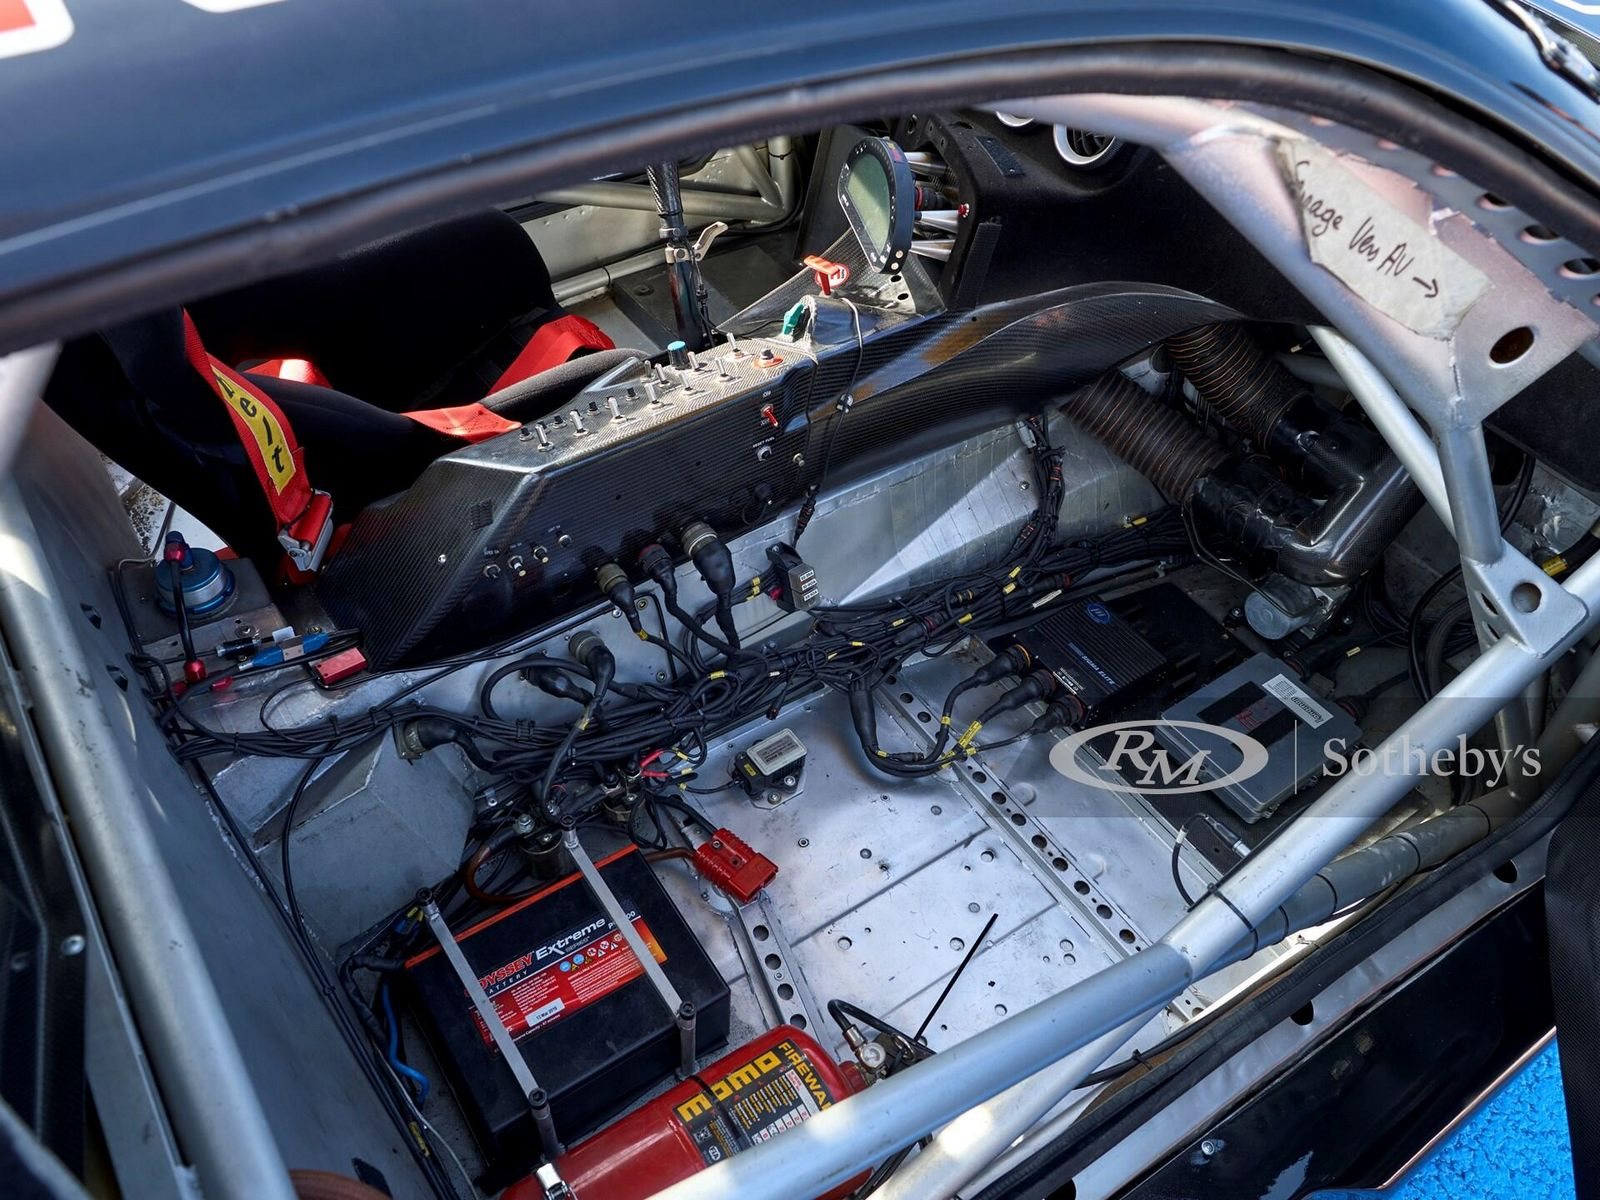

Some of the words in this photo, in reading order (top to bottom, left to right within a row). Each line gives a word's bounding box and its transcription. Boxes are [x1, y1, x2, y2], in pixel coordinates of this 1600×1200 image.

[464, 951, 534, 998] DYSSEY
[535, 917, 607, 961] Extreme
[676, 1050, 783, 1123] momo
[778, 1041, 832, 1112] FIREWAL
